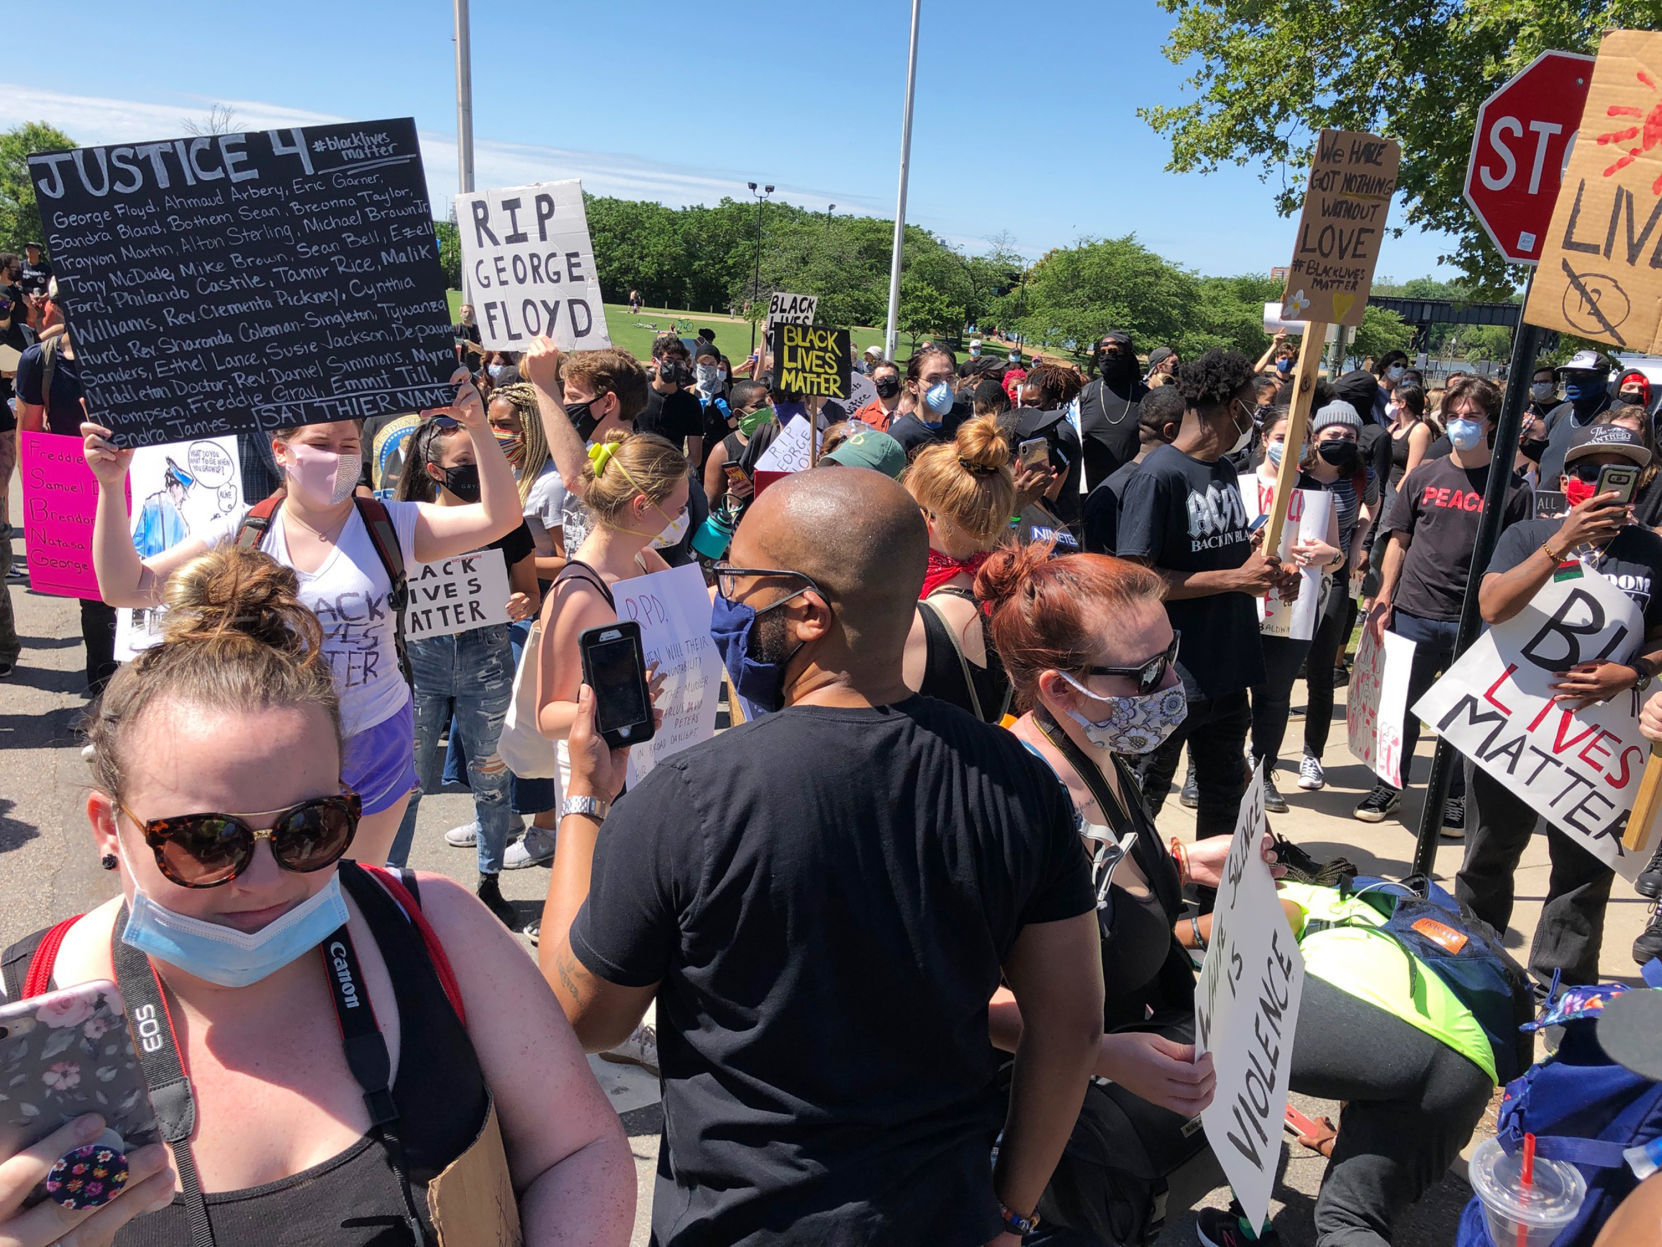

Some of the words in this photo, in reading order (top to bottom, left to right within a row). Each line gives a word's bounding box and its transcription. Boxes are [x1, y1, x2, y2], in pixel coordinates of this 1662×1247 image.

[28, 133, 259, 199] JUSTICE
[267, 128, 315, 176] 4
[341, 142, 398, 161] matter
[1320, 131, 1346, 165] We
[53, 209, 112, 229] George
[114, 199, 160, 220] Floyd,
[164, 189, 225, 210] Ahmaud
[231, 185, 288, 202] Arbery,
[293, 178, 326, 195] Eric
[333, 173, 384, 189] Garner,
[1310, 168, 1341, 193] GOT
[1340, 171, 1395, 196] NOTHING
[50, 230, 112, 252] Sandra
[117, 221, 167, 240] Bland,
[168, 212, 233, 232] Bothem
[290, 198, 357, 217] Breonna
[357, 186, 413, 208] Taylor,
[471, 193, 556, 249] RIP
[1321, 197, 1381, 223] WITHOUT
[1561, 178, 1662, 269] LIV
[54, 252, 118, 276] Trayvon
[120, 242, 179, 260] Martin,
[181, 234, 225, 254] Alton
[227, 224, 301, 246] Sterling,
[303, 210, 362, 234] Michael
[58, 275, 106, 296] Tony
[109, 266, 175, 289] McDade,
[179, 261, 226, 278] Mike
[230, 251, 294, 269] Brown,
[296, 240, 341, 259] Sean
[342, 231, 387, 249] Bell,
[389, 221, 434, 242] Ezell
[1299, 223, 1375, 261] LOVE
[64, 298, 113, 318] Ford,
[111, 286, 190, 309] Philando
[196, 272, 275, 295] Castile,
[273, 264, 329, 283] Tamir
[331, 255, 381, 275] Rice,
[475, 251, 585, 289] GEORGE
[1310, 279, 1359, 292] MATTER
[70, 317, 164, 346] Williams,
[163, 306, 200, 327] Rev.
[199, 295, 272, 321] Clementa
[274, 287, 347, 308] Pickney,
[349, 276, 416, 302] Cynthia
[484, 298, 593, 341] FLOYD
[769, 294, 815, 315] BLACK
[76, 344, 129, 368] Hurd,
[128, 339, 160, 360] Rev.
[159, 329, 234, 355] Sharonda
[239, 309, 379, 343] Coleman-Singleton,
[377, 298, 448, 324] Tywanza
[783, 325, 842, 357] BLACK
[80, 365, 153, 388] Sanders,
[154, 353, 208, 379] Ethel
[214, 350, 269, 372] Lance,
[266, 340, 319, 361] Susie
[321, 328, 394, 350] Jackson,
[85, 382, 172, 409] Middleton
[171, 377, 234, 397] Doctor,
[232, 370, 270, 390] Rev.
[268, 360, 324, 384] Daniel
[327, 354, 410, 376] Simmons,
[411, 348, 455, 367] Myra
[783, 345, 838, 374] LIVES
[89, 404, 191, 428] Thompson,
[186, 392, 264, 416] Freddie
[271, 385, 326, 403] Gray,
[330, 369, 393, 395] Emmit
[394, 364, 438, 386] Till,
[780, 369, 845, 399] MATTER
[261, 405, 308, 428] SAY
[313, 392, 398, 419] THIER
[29, 440, 84, 465] Freddie
[105, 427, 167, 449] endra
[30, 467, 84, 495] Samuel
[30, 527, 86, 552] Natasa
[30, 549, 89, 575] George
[1191, 533, 1224, 553] BACK
[1224, 531, 1234, 546] IN
[1483, 663, 1645, 789] LIVES
[1229, 784, 1261, 911] SILENCE
[329, 941, 360, 1009] Canon
[1227, 940, 1243, 1000] IS
[134, 1003, 163, 1053] EOS
[1227, 928, 1293, 1173] VIOLENCE
